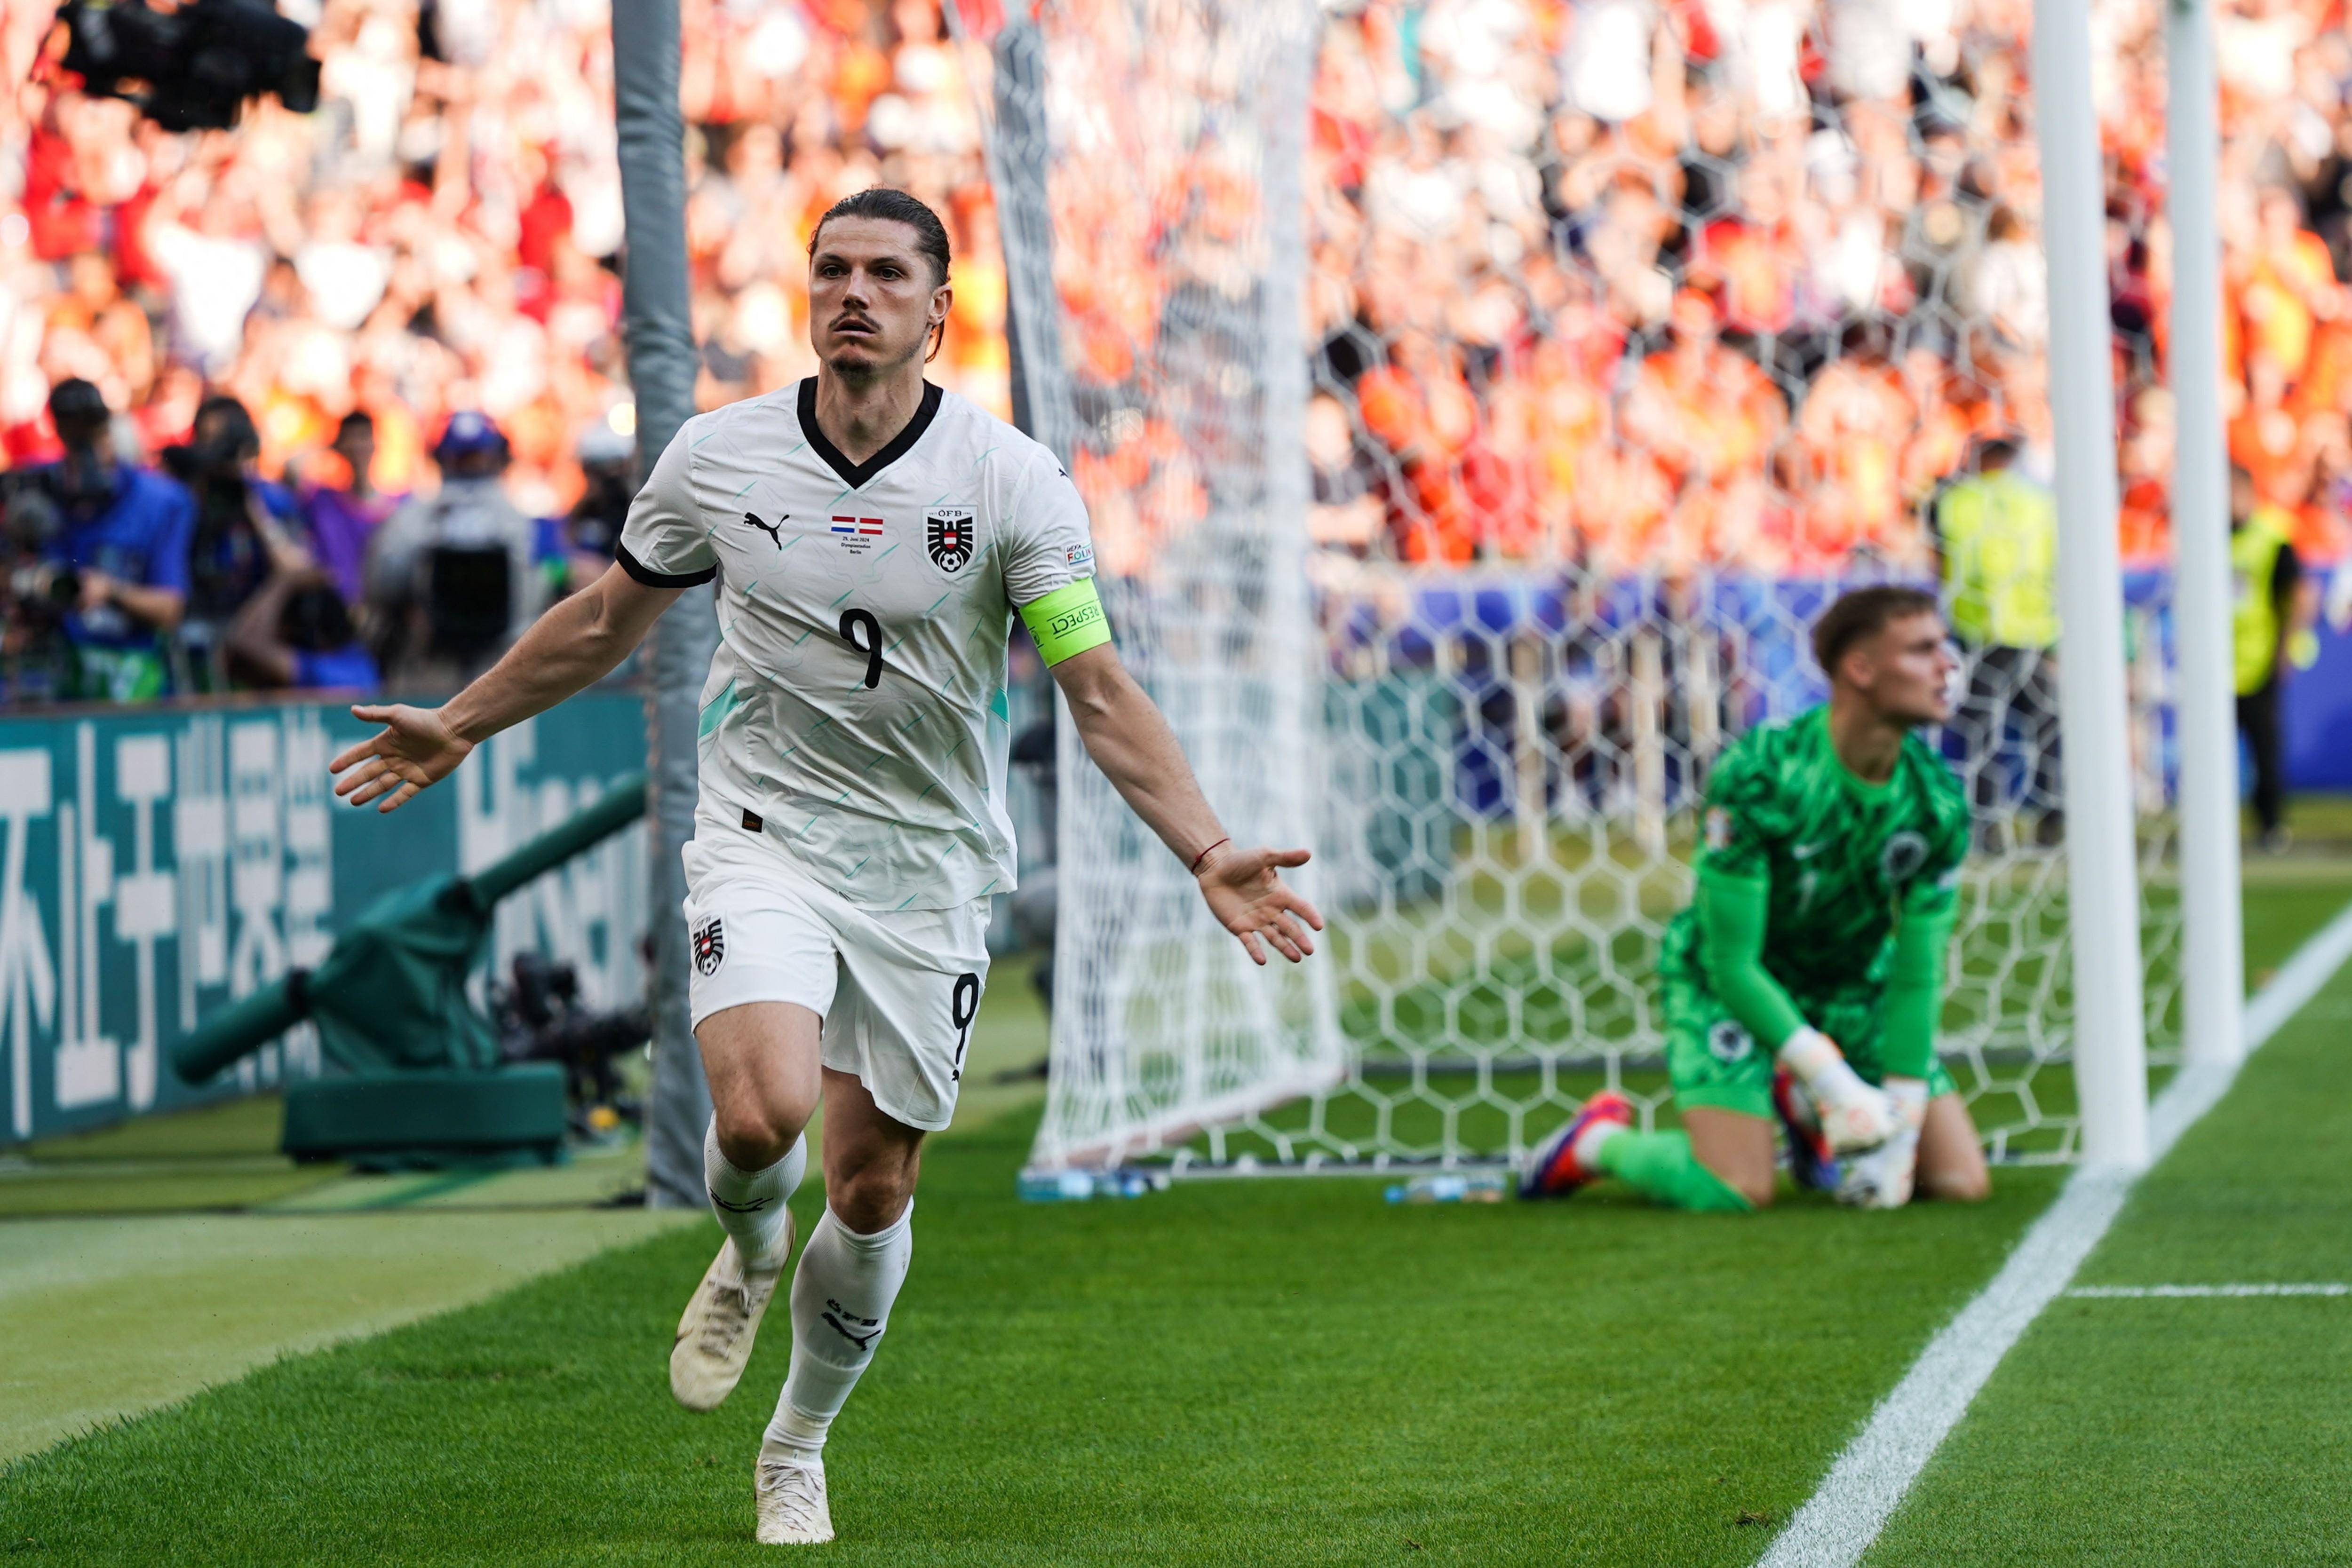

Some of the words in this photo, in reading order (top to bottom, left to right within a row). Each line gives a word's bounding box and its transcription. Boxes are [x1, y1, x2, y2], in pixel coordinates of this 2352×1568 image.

[839, 608, 882, 689] 9
[1051, 604, 1100, 635] RESPECT
[952, 972, 979, 1065] 9
